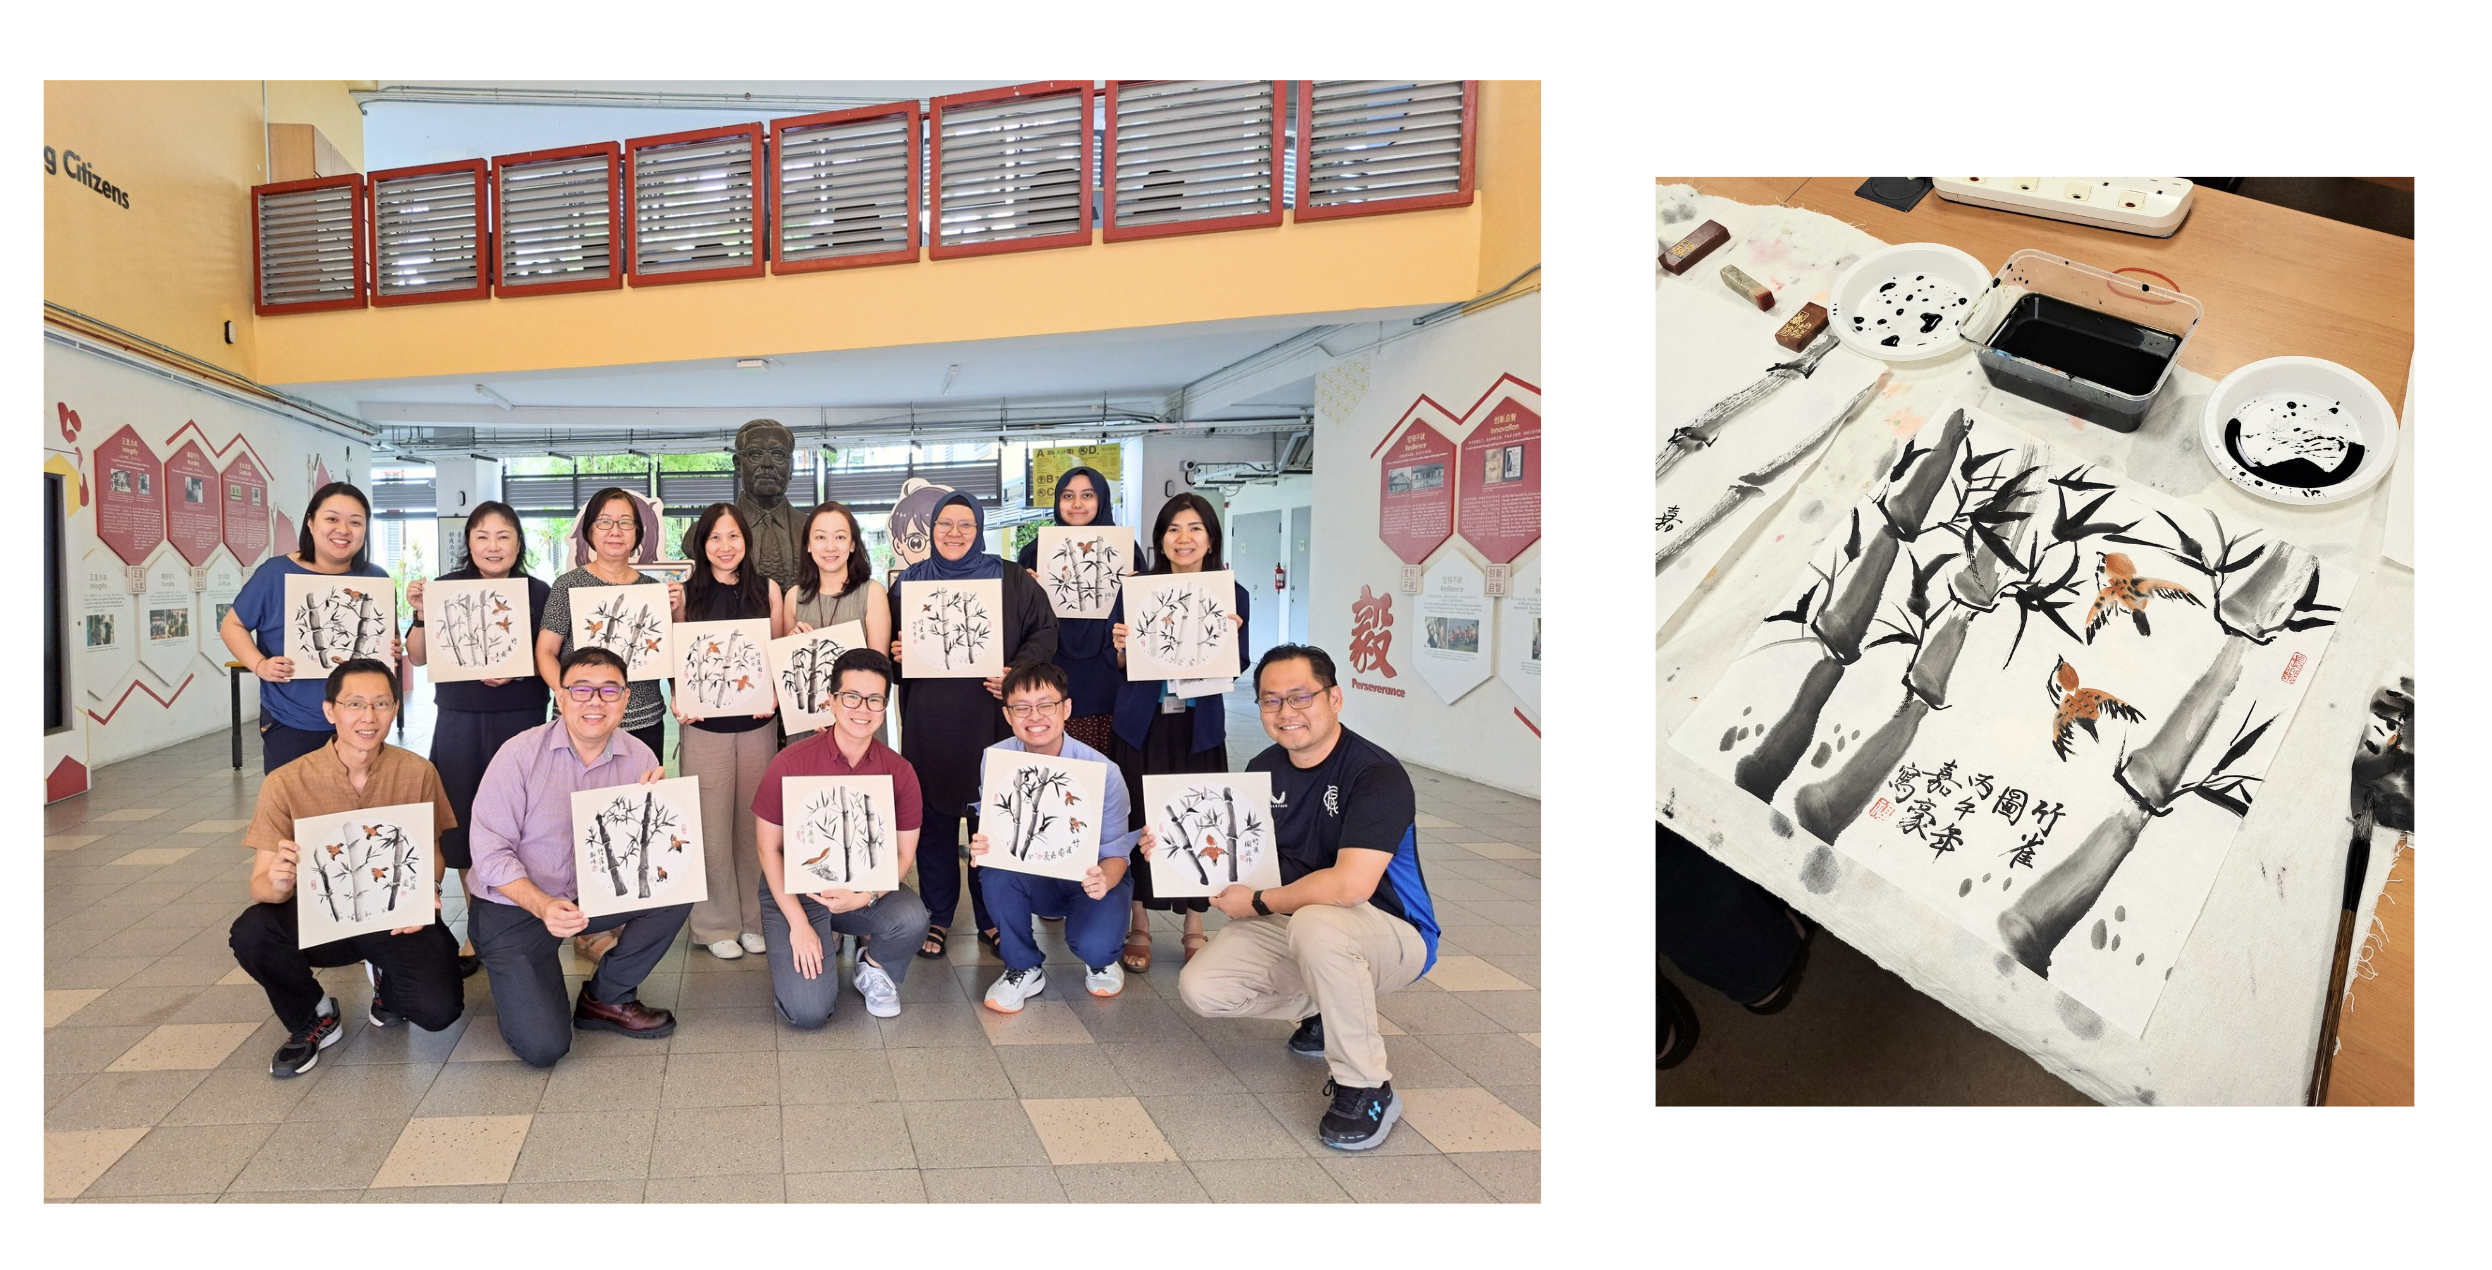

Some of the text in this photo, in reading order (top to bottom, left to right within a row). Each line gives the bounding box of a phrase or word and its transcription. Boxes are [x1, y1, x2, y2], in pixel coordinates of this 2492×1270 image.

[63, 150, 129, 209] Citizens
[1490, 424, 1520, 434] Innovation
[1036, 449, 1045, 458] A
[1351, 678, 1406, 698] Perseverance
